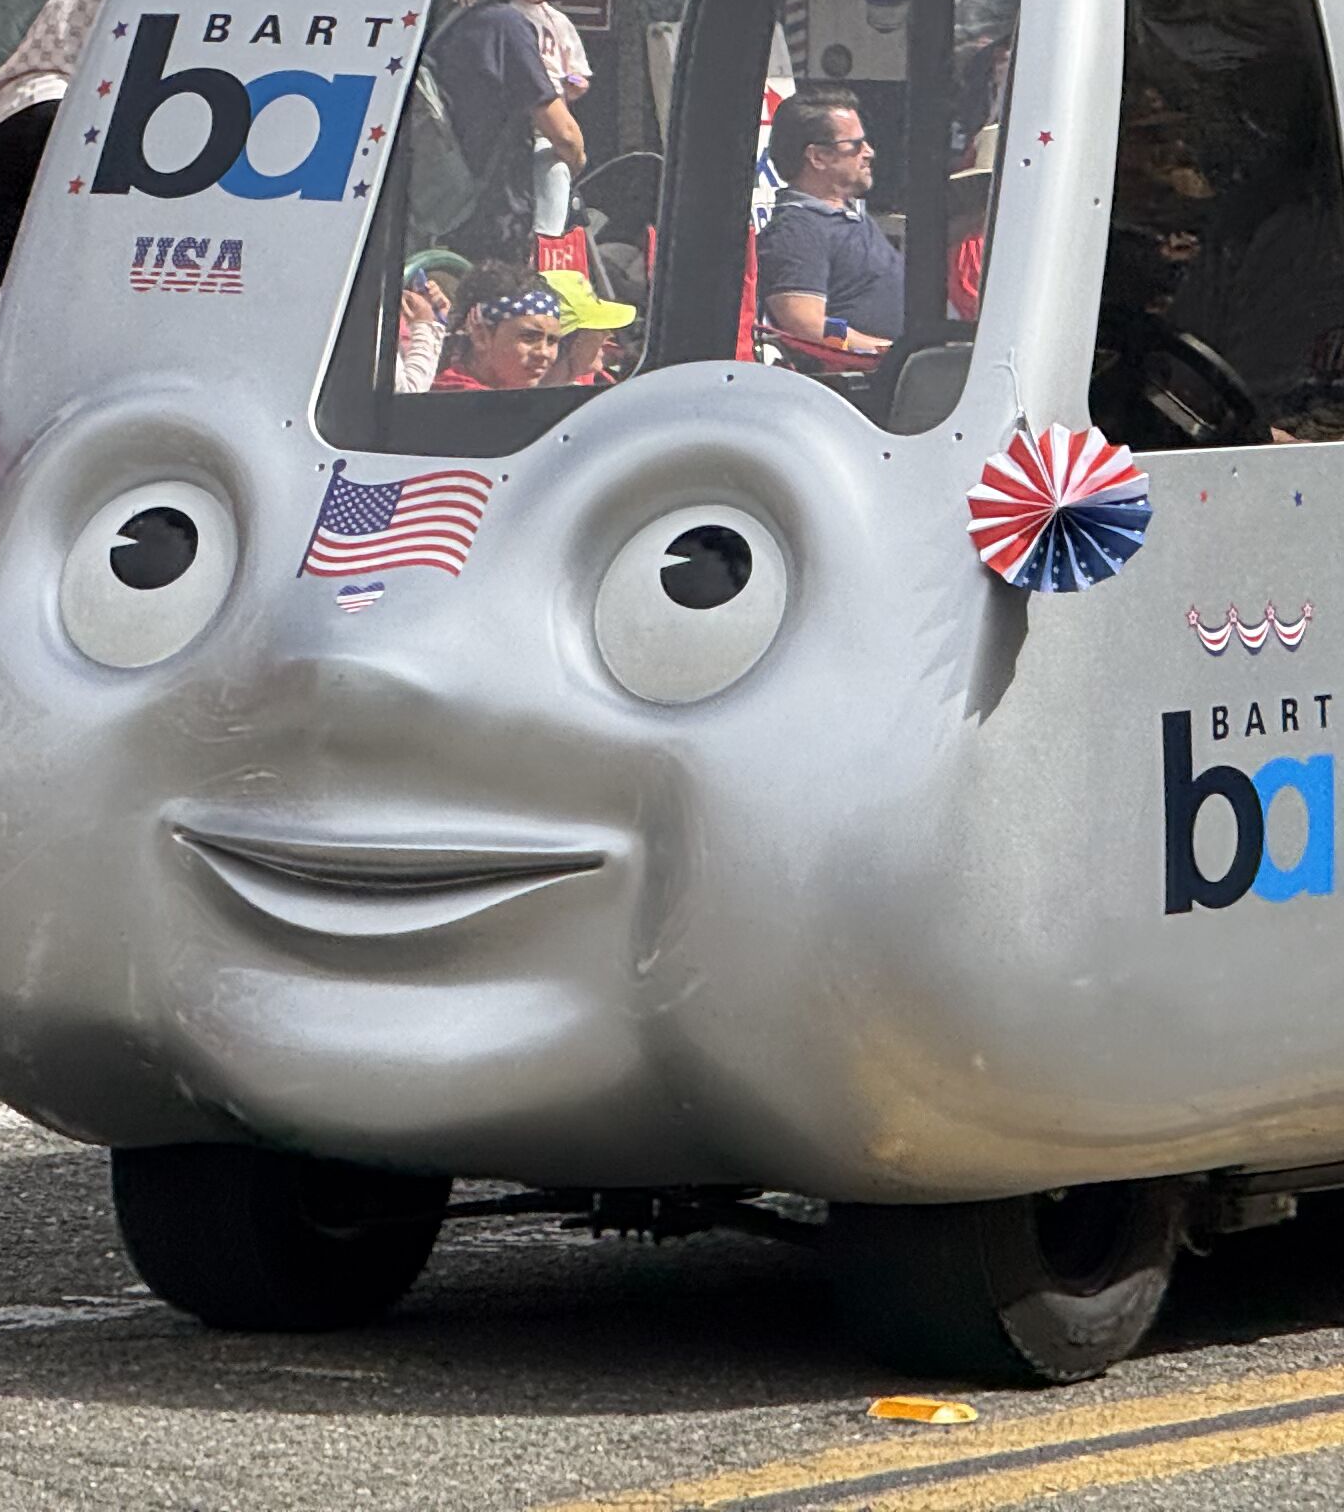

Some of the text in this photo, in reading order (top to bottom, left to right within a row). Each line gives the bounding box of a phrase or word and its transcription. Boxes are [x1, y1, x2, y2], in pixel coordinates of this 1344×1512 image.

[202, 13, 395, 48] BART
[90, 13, 377, 202] ba
[129, 236, 245, 295] USA
[1211, 694, 1333, 741] BART
[1162, 709, 1336, 916] ba
